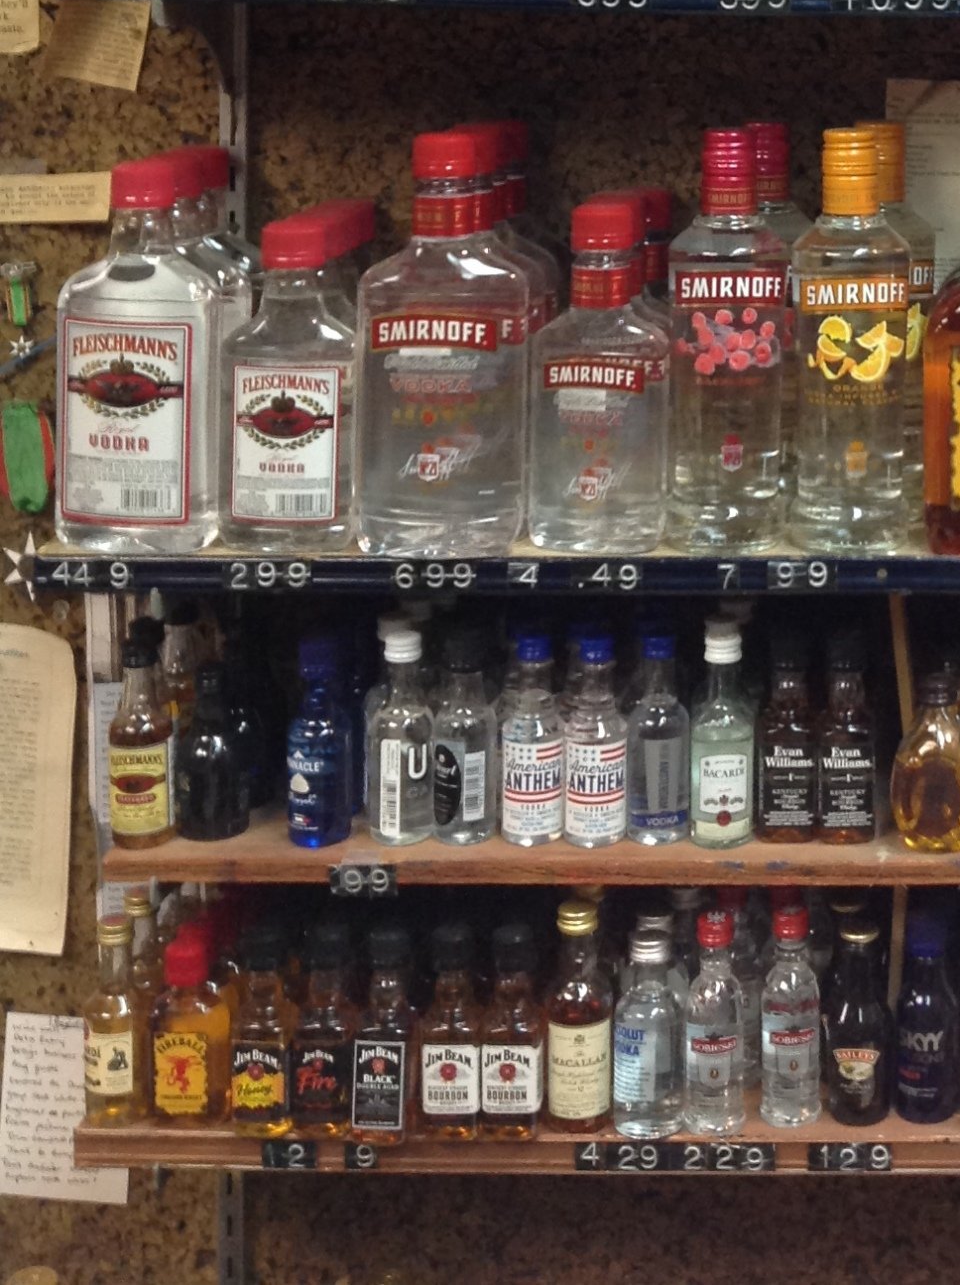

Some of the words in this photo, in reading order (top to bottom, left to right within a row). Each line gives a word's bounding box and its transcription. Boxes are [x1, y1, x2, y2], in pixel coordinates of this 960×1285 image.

[681, 276, 782, 299] SMIRNOFF
[807, 282, 905, 305] SMIRNOFF
[378, 319, 487, 345] SMIRNOFF
[72, 332, 178, 361] FLEISCHMANN'S
[242, 374, 330, 395] FLEISCHMANN'S
[549, 364, 636, 387] SMIRNOFF
[89, 434, 150, 452] VODKA
[259, 462, 305, 473] VODKA
[773, 746, 805, 757] Evan
[831, 746, 861, 758] Evan
[765, 757, 814, 768] Williams
[822, 757, 872, 769] Williams
[504, 770, 561, 792] ANTHEM
[568, 771, 624, 795] ANTHEM
[233, 1050, 251, 1066] JIM
[252, 1048, 279, 1065] BEAM
[358, 1047, 375, 1064] JIM
[375, 1046, 399, 1064] BEAM
[425, 1051, 443, 1068] JIM
[445, 1049, 472, 1066] BEAM
[484, 1051, 502, 1068] JIM
[504, 1049, 530, 1066] BEAM
[363, 1074, 394, 1083] BLACK
[427, 1089, 468, 1101] BOURBON
[486, 1089, 527, 1101] BOURBON
